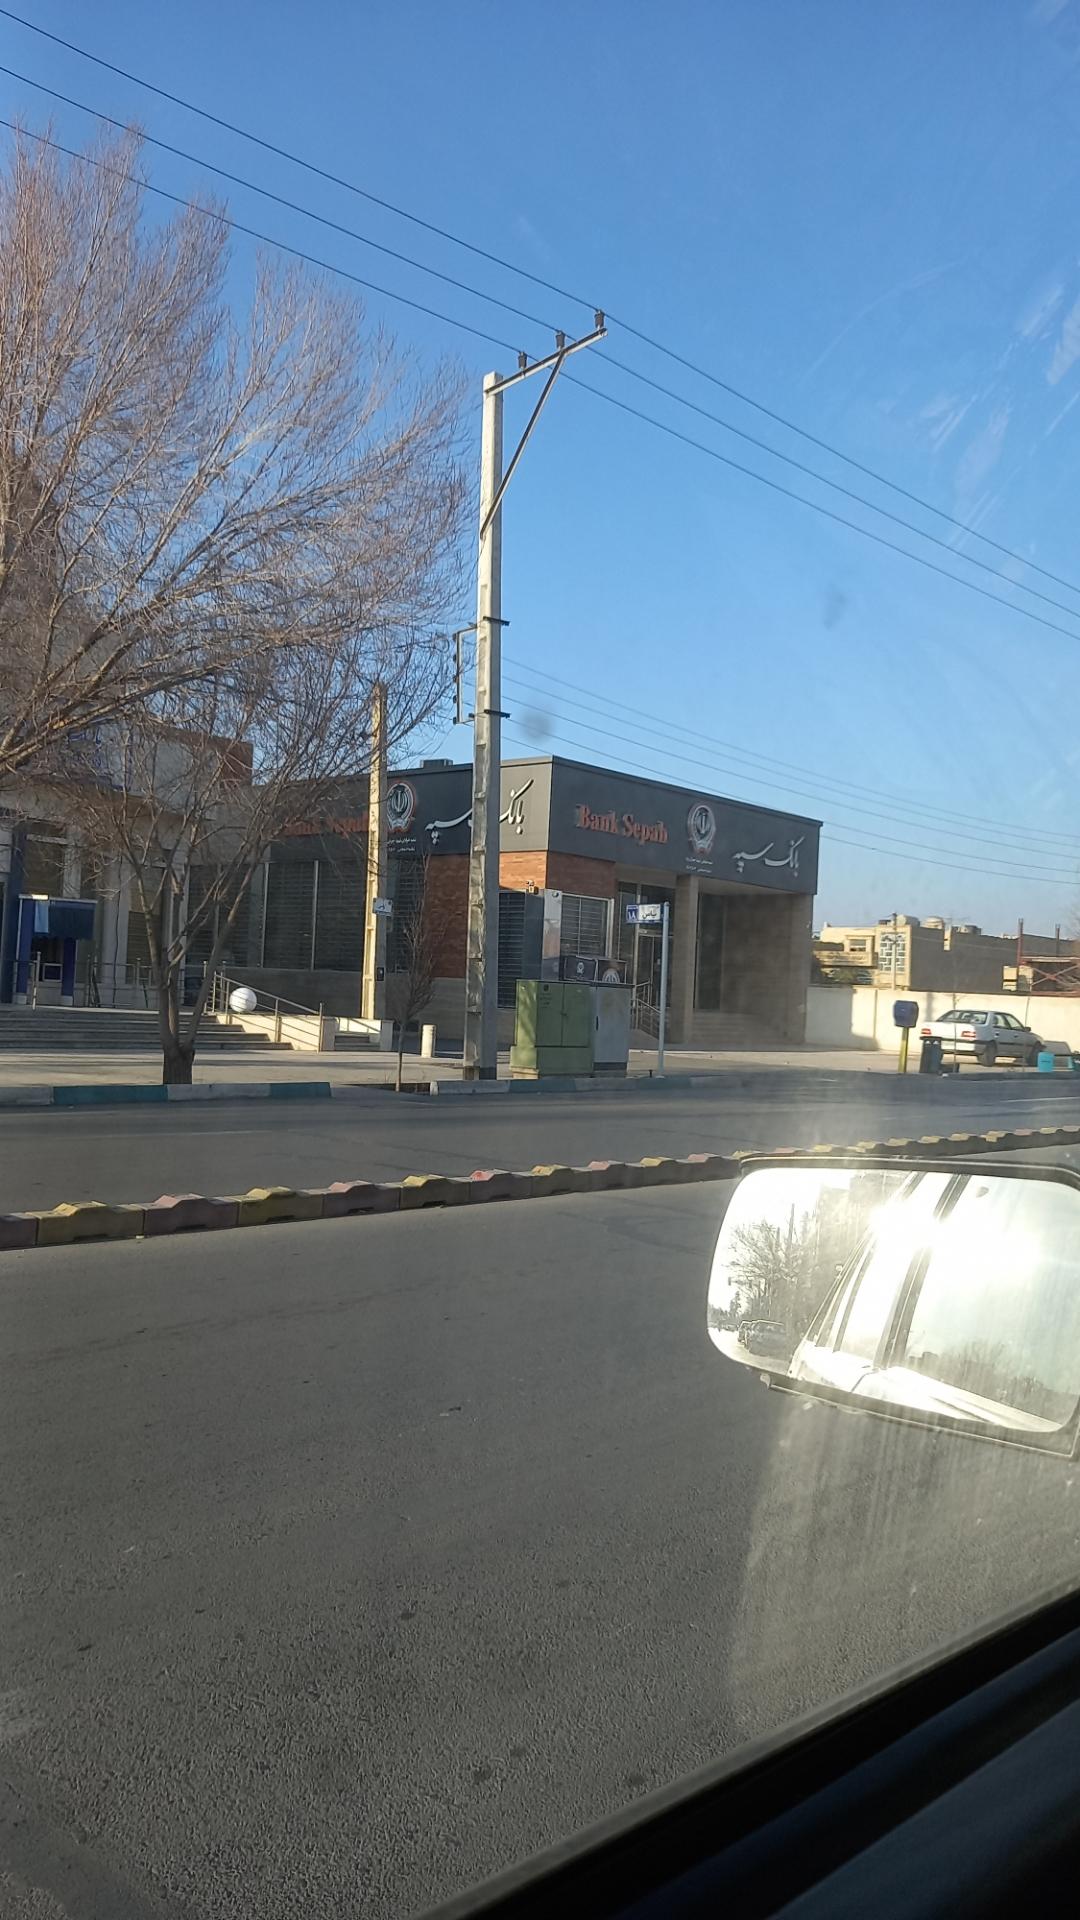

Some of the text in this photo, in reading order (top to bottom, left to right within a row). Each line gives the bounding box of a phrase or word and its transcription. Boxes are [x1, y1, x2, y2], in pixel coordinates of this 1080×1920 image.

[576, 803, 668, 846] Bank Sepah
[732, 836, 805, 878] بانک سپه
